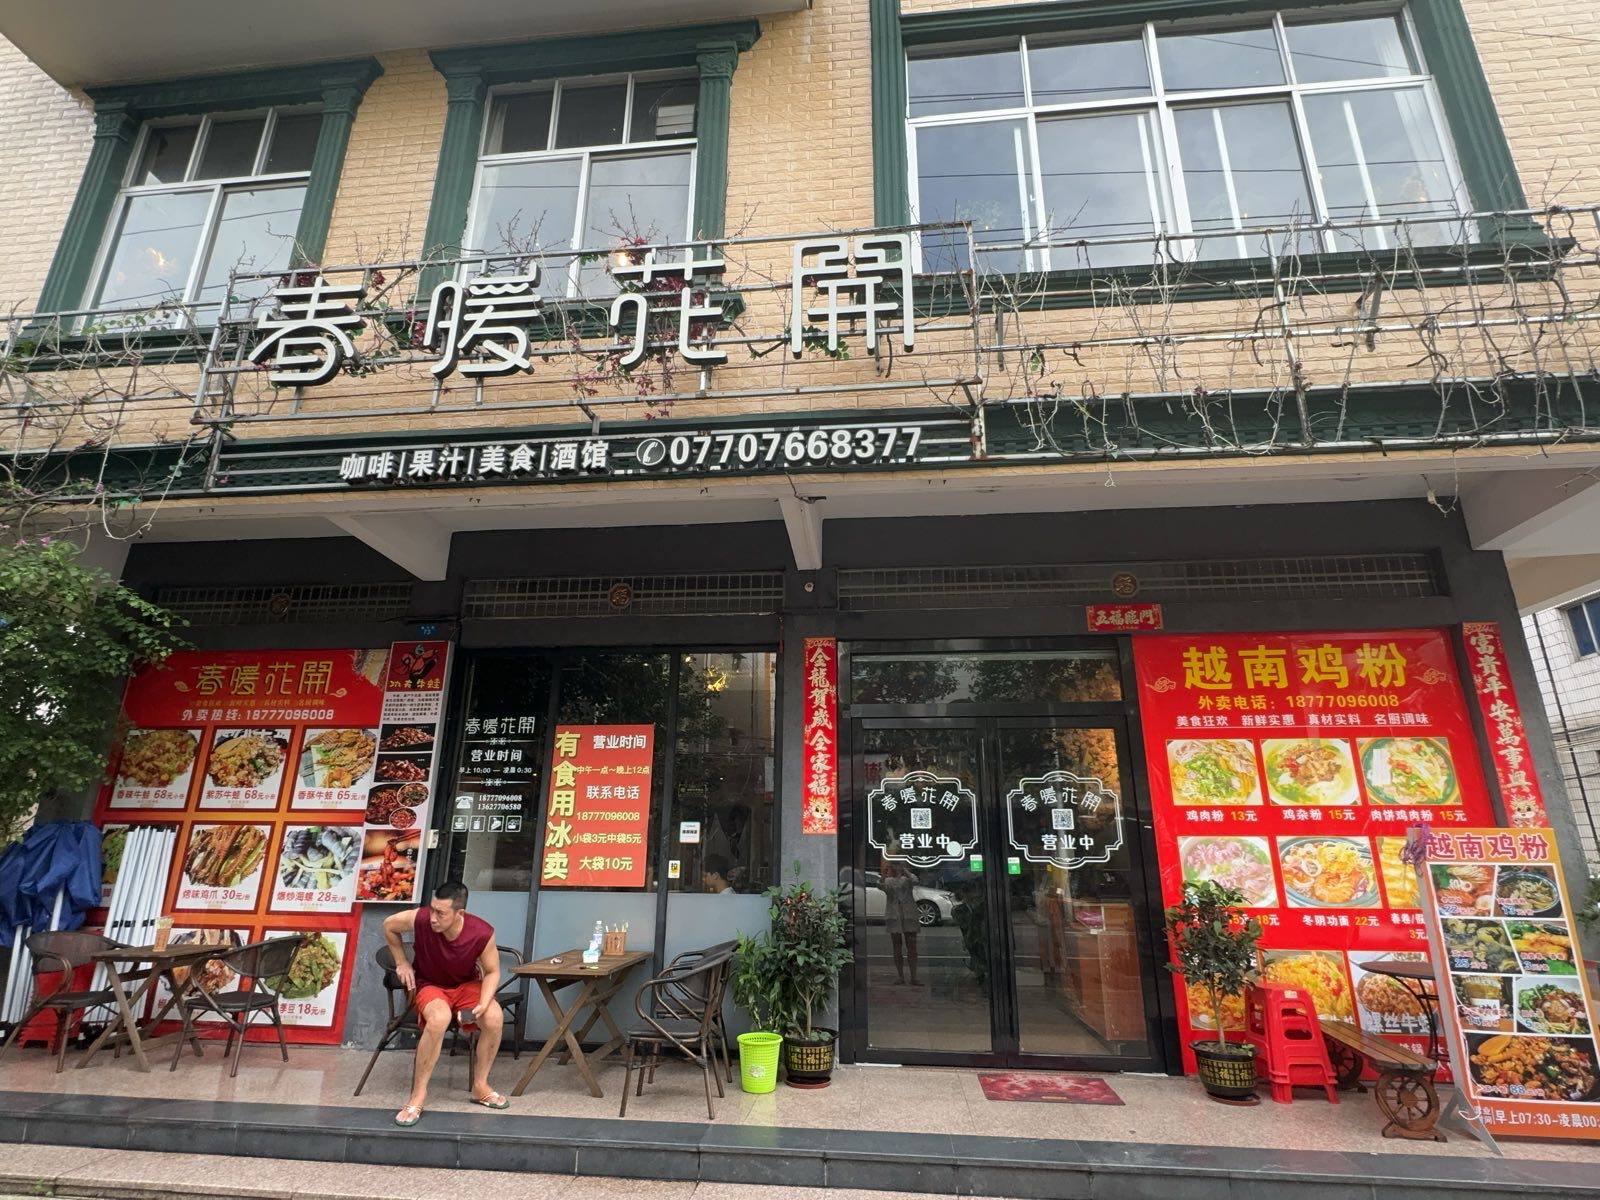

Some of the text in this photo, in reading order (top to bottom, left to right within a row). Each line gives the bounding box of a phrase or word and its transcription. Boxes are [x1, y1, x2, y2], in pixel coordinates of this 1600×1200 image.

[670, 427, 922, 465] 07707668377
[1182, 642, 1408, 690] 越南鸡粉
[196, 660, 334, 696] 春暖花開
[1286, 694, 1400, 709] 18777096008
[246, 709, 334, 720] 18777096008
[1176, 712, 1432, 727] 美食狂欢 新鲜实惠 真材实料 名厨调味
[465, 716, 536, 735] 春暖花開
[593, 735, 647, 749] 营业时间
[471, 749, 523, 762] 营业时间
[479, 794, 523, 802] 18777096008
[585, 785, 641, 800] 联系电话
[881, 786, 960, 812] 春暖花開
[1021, 785, 1102, 813] 春暖花開
[477, 803, 522, 811] 13627706580
[543, 731, 580, 880] 有食用冰卖
[577, 811, 641, 821] 18777096008
[1186, 810, 1258, 822] 鸡肉粉 13元
[1282, 808, 1356, 821] 鸡杂粉 15元
[1440, 809, 1468, 822] 15元
[573, 833, 642, 845] 小袋3元中袋5元
[899, 832, 951, 849] 营业中
[1041, 834, 1095, 851] 营业中
[1427, 832, 1549, 861] 越南鸡粉
[579, 856, 634, 871] 大袋10元
[1355, 915, 1380, 927] 22元
